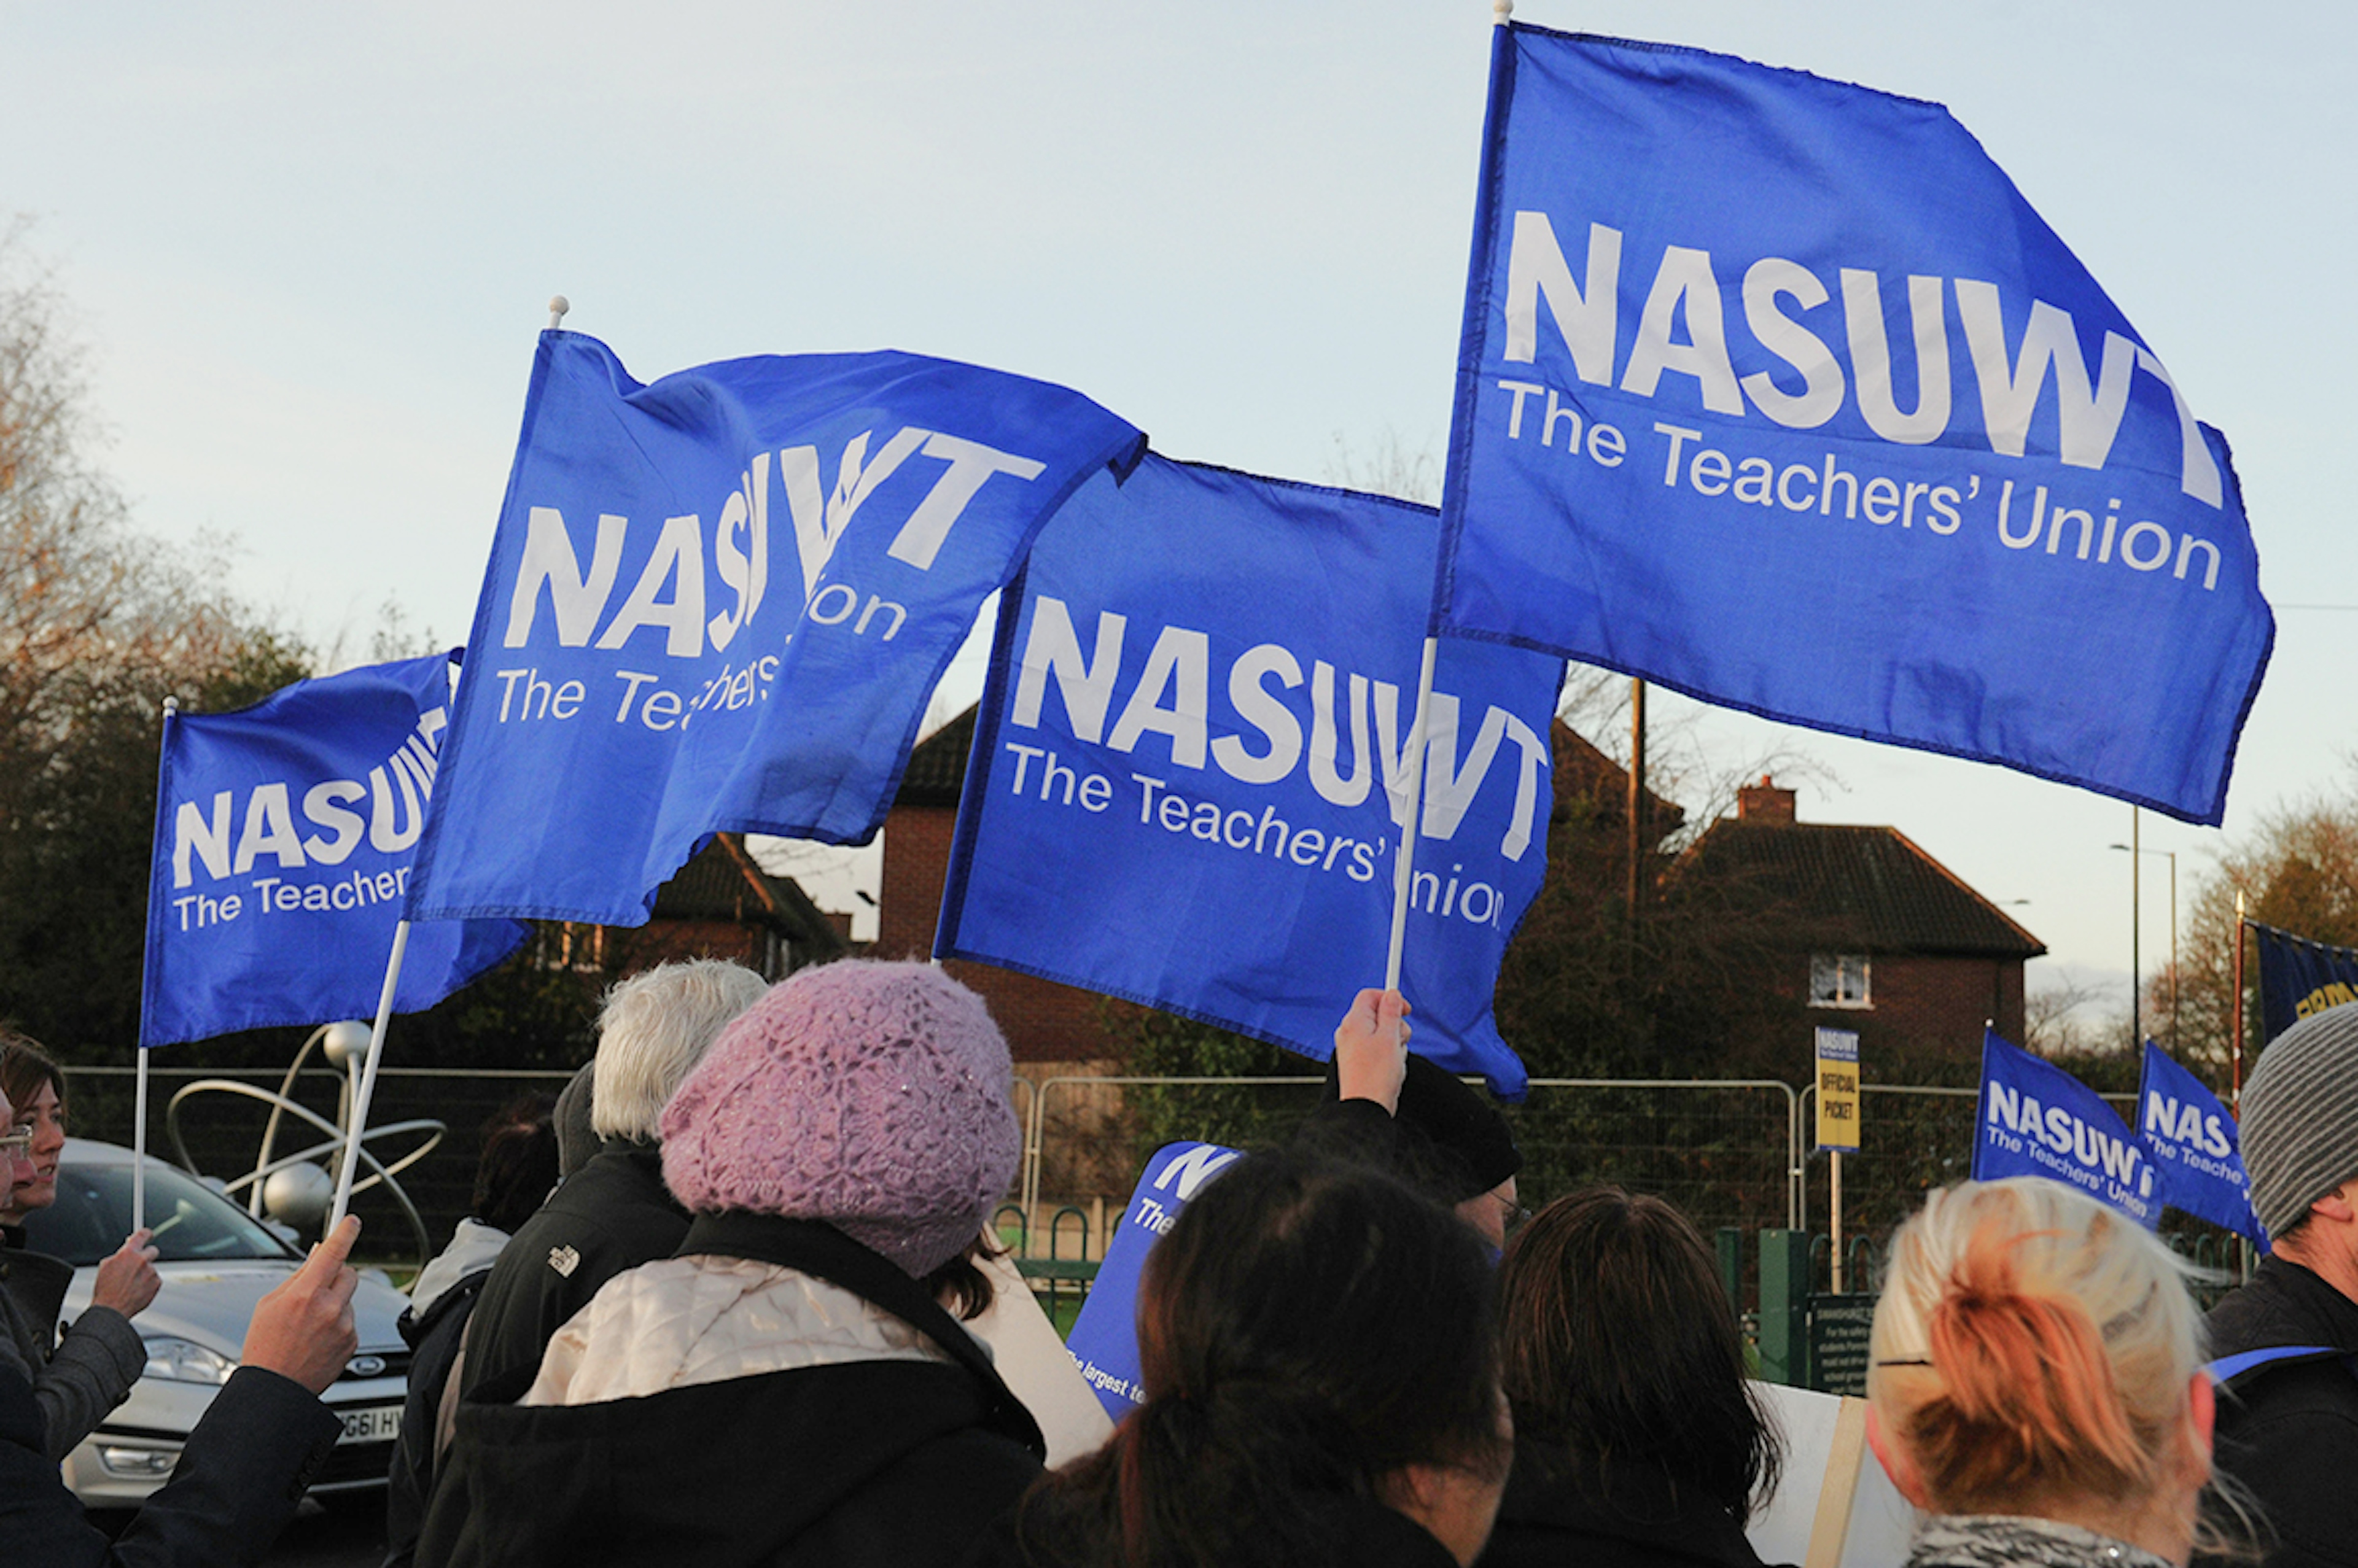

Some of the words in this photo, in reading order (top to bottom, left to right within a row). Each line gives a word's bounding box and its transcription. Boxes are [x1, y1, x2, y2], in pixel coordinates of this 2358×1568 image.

[1497, 379, 1627, 468] The
[1654, 422, 1979, 535] Teachers'
[1996, 480, 2222, 591] Union
[497, 668, 585, 722] The
[1011, 594, 1548, 862] NASUWT
[1005, 742, 1113, 813] The
[1130, 772, 1386, 882] Teachers'
[173, 894, 241, 931] The
[252, 866, 410, 913] Teacher
[1822, 1073, 1855, 1093] OFFICIAL
[1825, 1100, 1853, 1120] PICKET
[2146, 1090, 2232, 1158] NAS
[1153, 1144, 1241, 1202] N
[1987, 1125, 2022, 1153] The
[2026, 1139, 2105, 1190] Teachers'
[2107, 1180, 2147, 1218] Union
[2181, 1146, 2243, 1185] Teache
[1134, 1197, 1175, 1236] The
[1082, 1360, 1129, 1396] largest
[1129, 1384, 1147, 1404] te
[342, 1413, 377, 1438] G61
